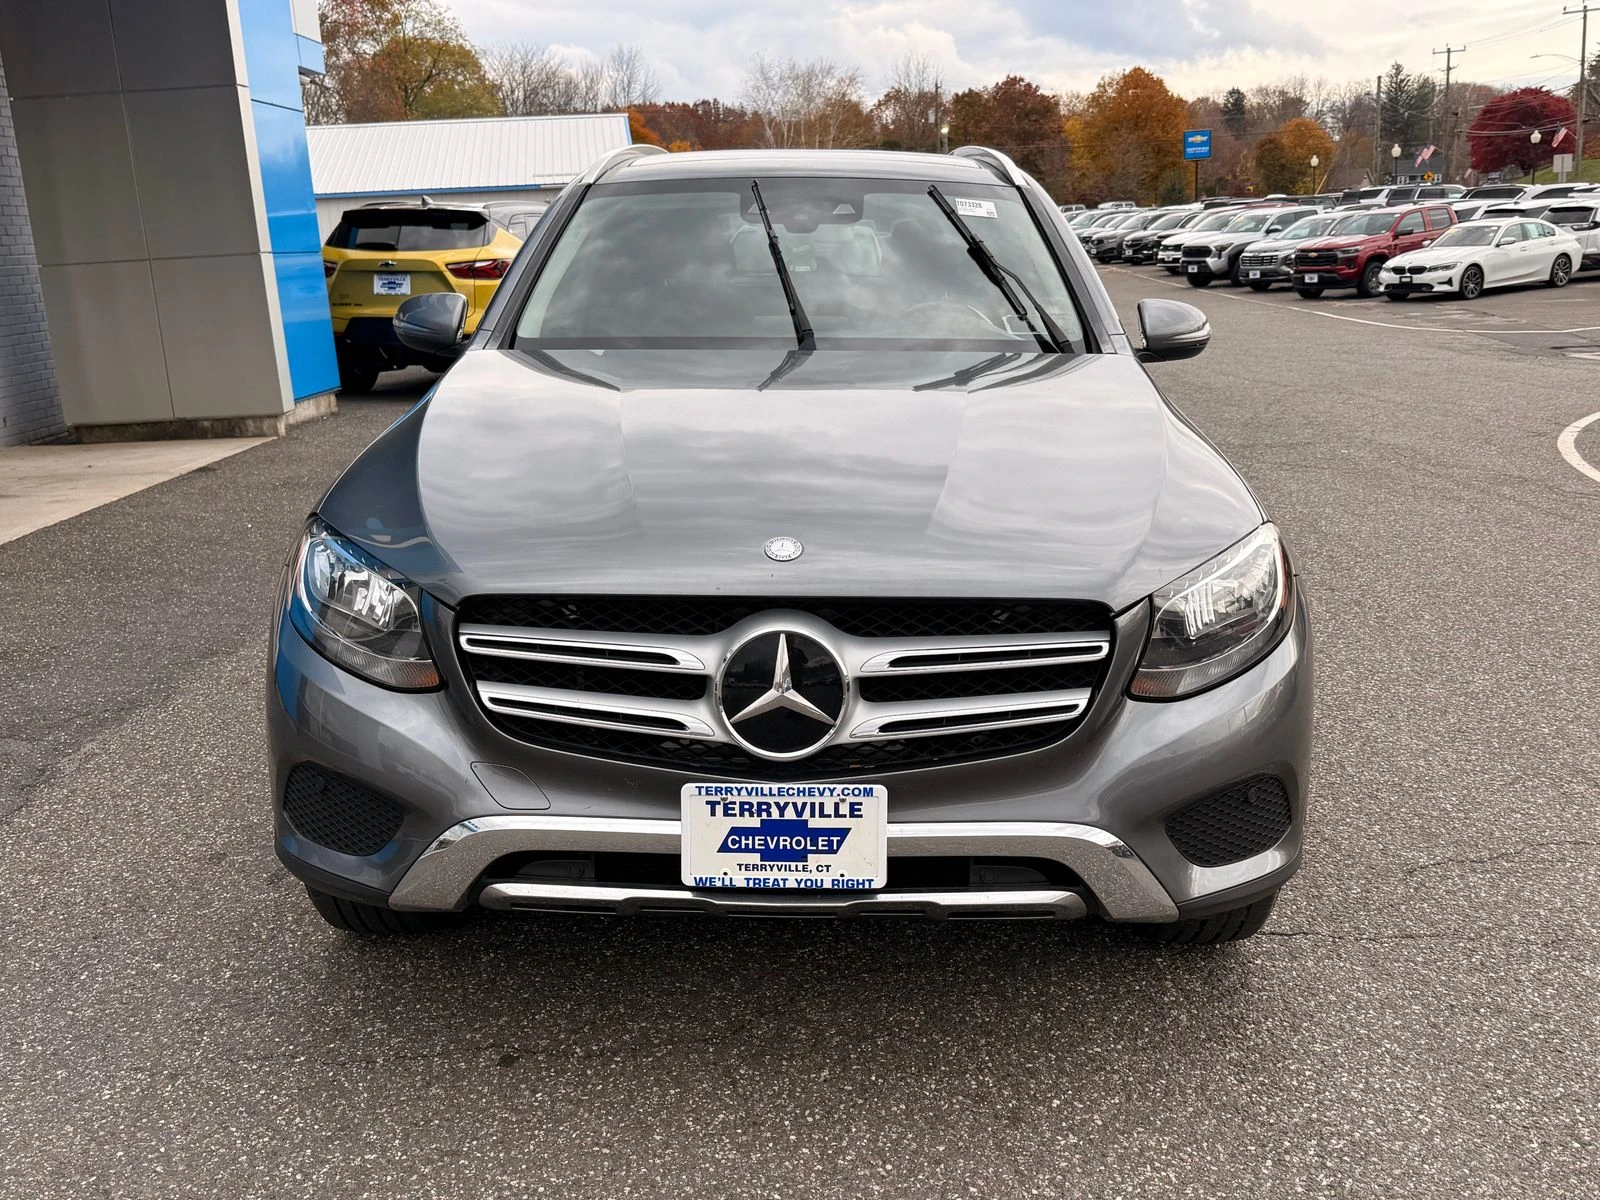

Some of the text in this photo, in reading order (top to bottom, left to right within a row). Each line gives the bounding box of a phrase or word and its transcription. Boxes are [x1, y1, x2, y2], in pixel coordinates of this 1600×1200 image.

[695, 785, 874, 797] TERRYVILLECHEVY.COM
[705, 800, 864, 818] TERRYVILLE
[727, 835, 841, 850] CHEVROLET
[736, 863, 832, 874] TERRYVILLE, CT
[694, 876, 875, 888] WE'LL TREAT YOU RIGHT
